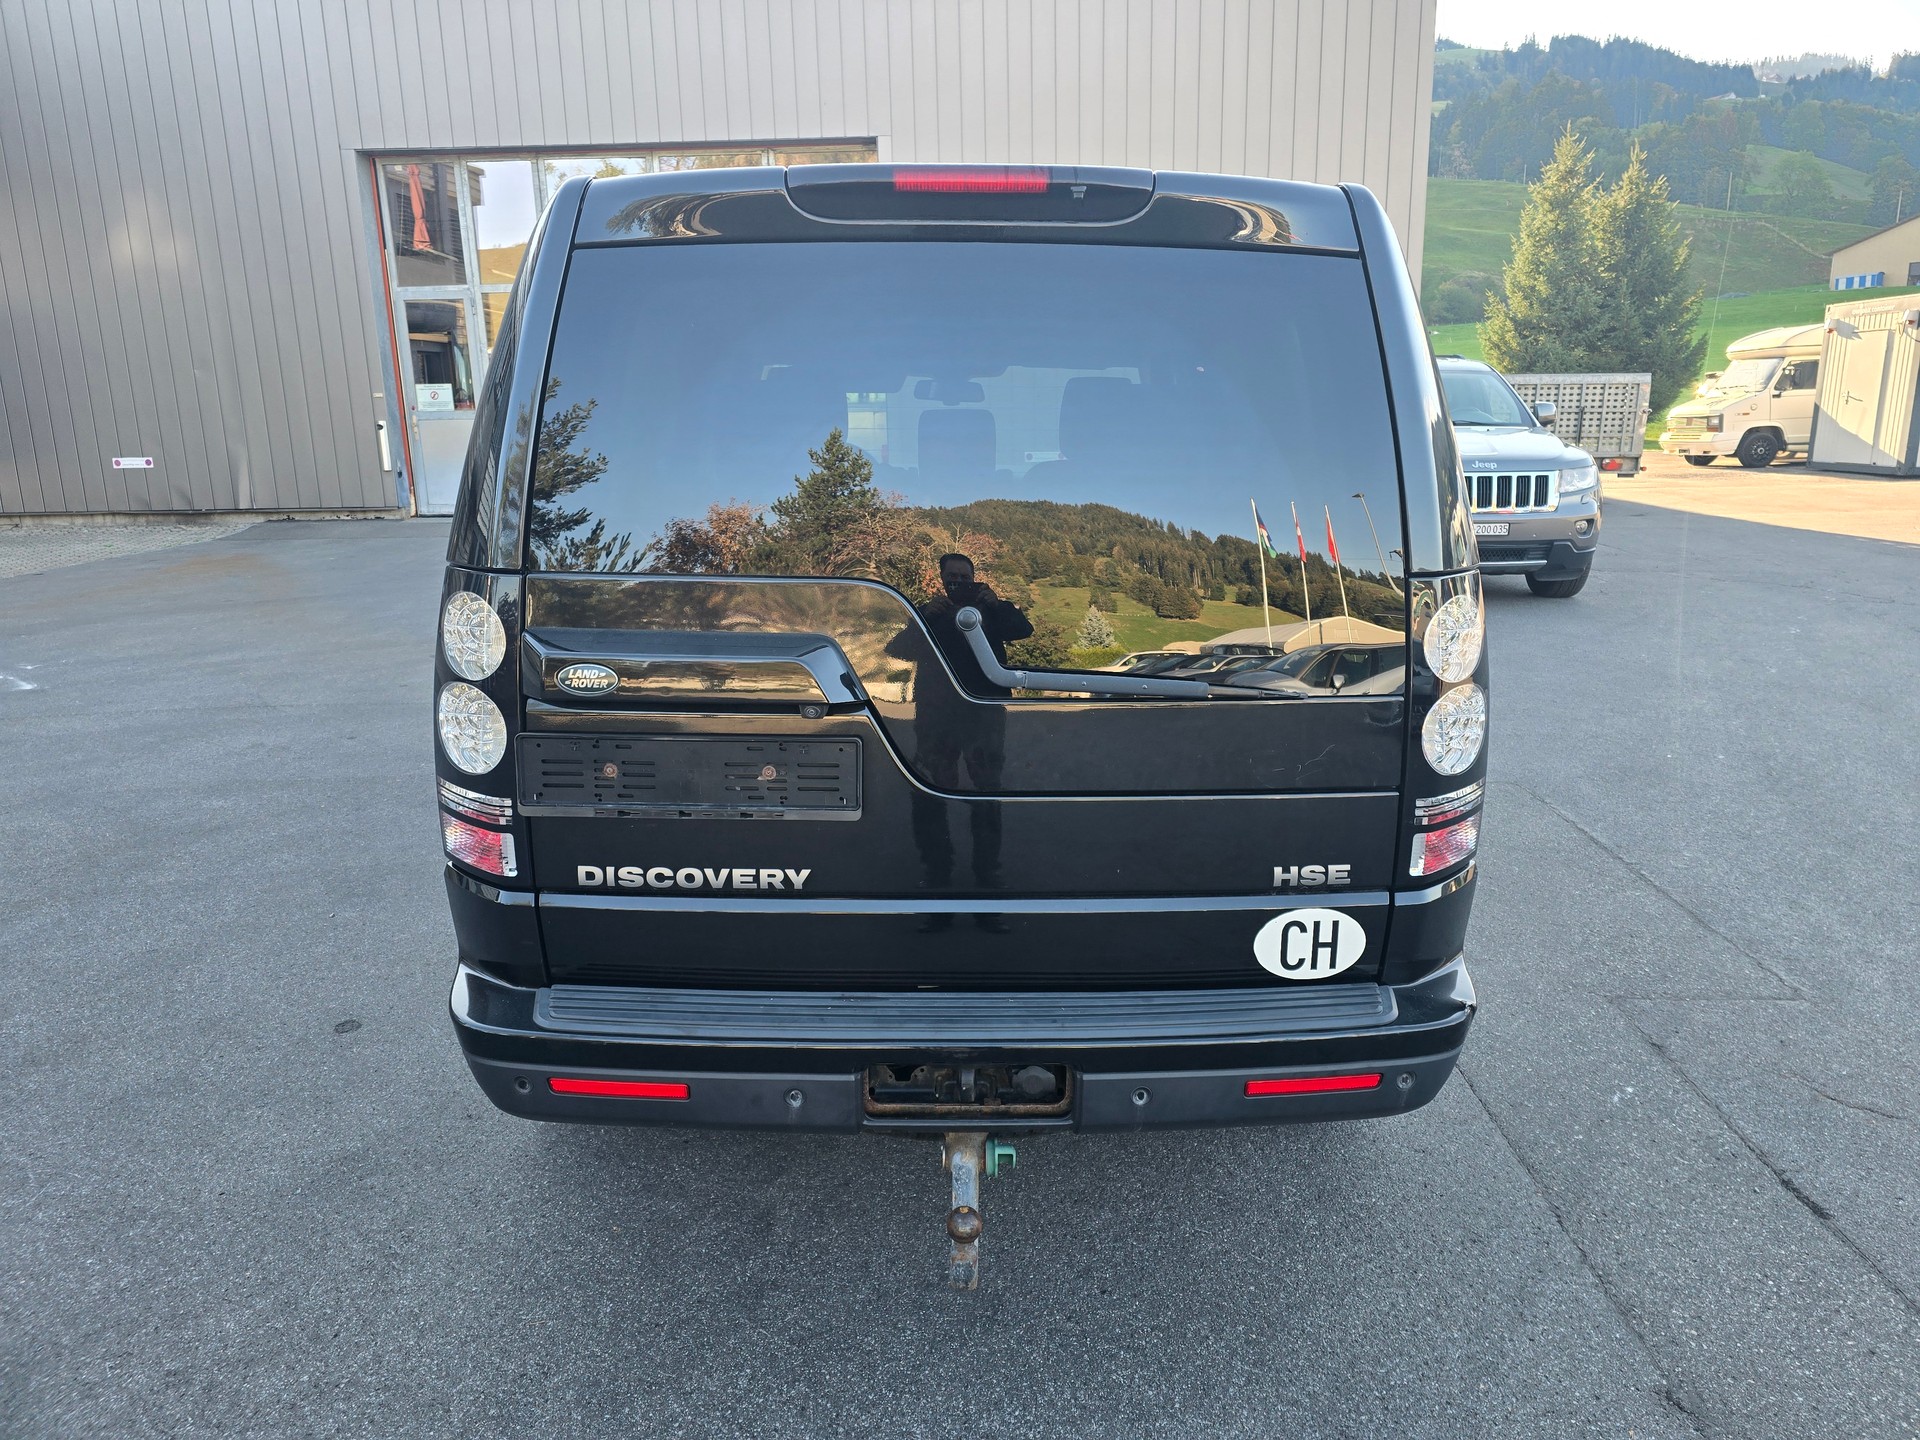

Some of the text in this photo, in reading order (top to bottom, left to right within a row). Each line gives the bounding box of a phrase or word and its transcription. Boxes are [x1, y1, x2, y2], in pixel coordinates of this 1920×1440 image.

[1472, 461, 1497, 469] Jeep
[568, 669, 598, 679] LAND
[571, 678, 608, 688] ROVER
[577, 865, 812, 890] DISCOVERY
[1273, 864, 1351, 887] HSE
[1280, 920, 1340, 971] CH
